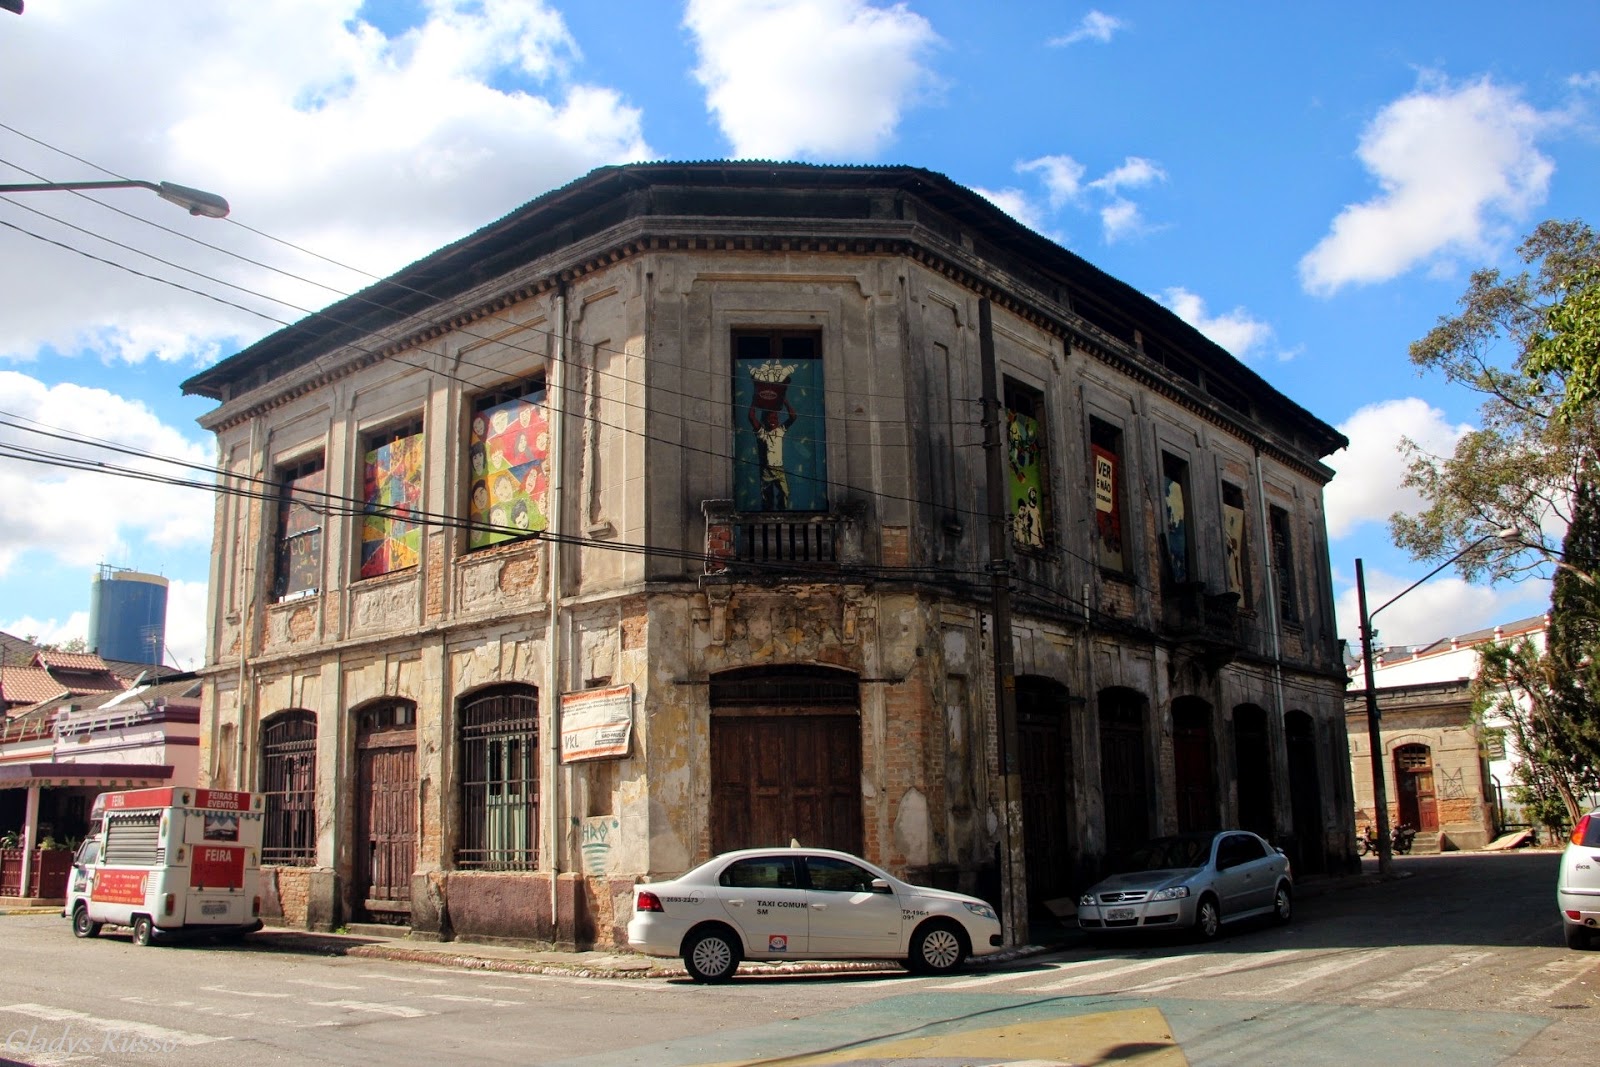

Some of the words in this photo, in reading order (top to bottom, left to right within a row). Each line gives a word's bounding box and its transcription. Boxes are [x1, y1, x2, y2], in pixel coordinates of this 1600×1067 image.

[1098, 460, 1110, 479] VER
[112, 795, 125, 807] FEIRA
[208, 791, 233, 801] FEIRAS
[234, 793, 239, 801] E
[207, 800, 239, 809] EVENTOS
[205, 849, 232, 862] FEIRA
